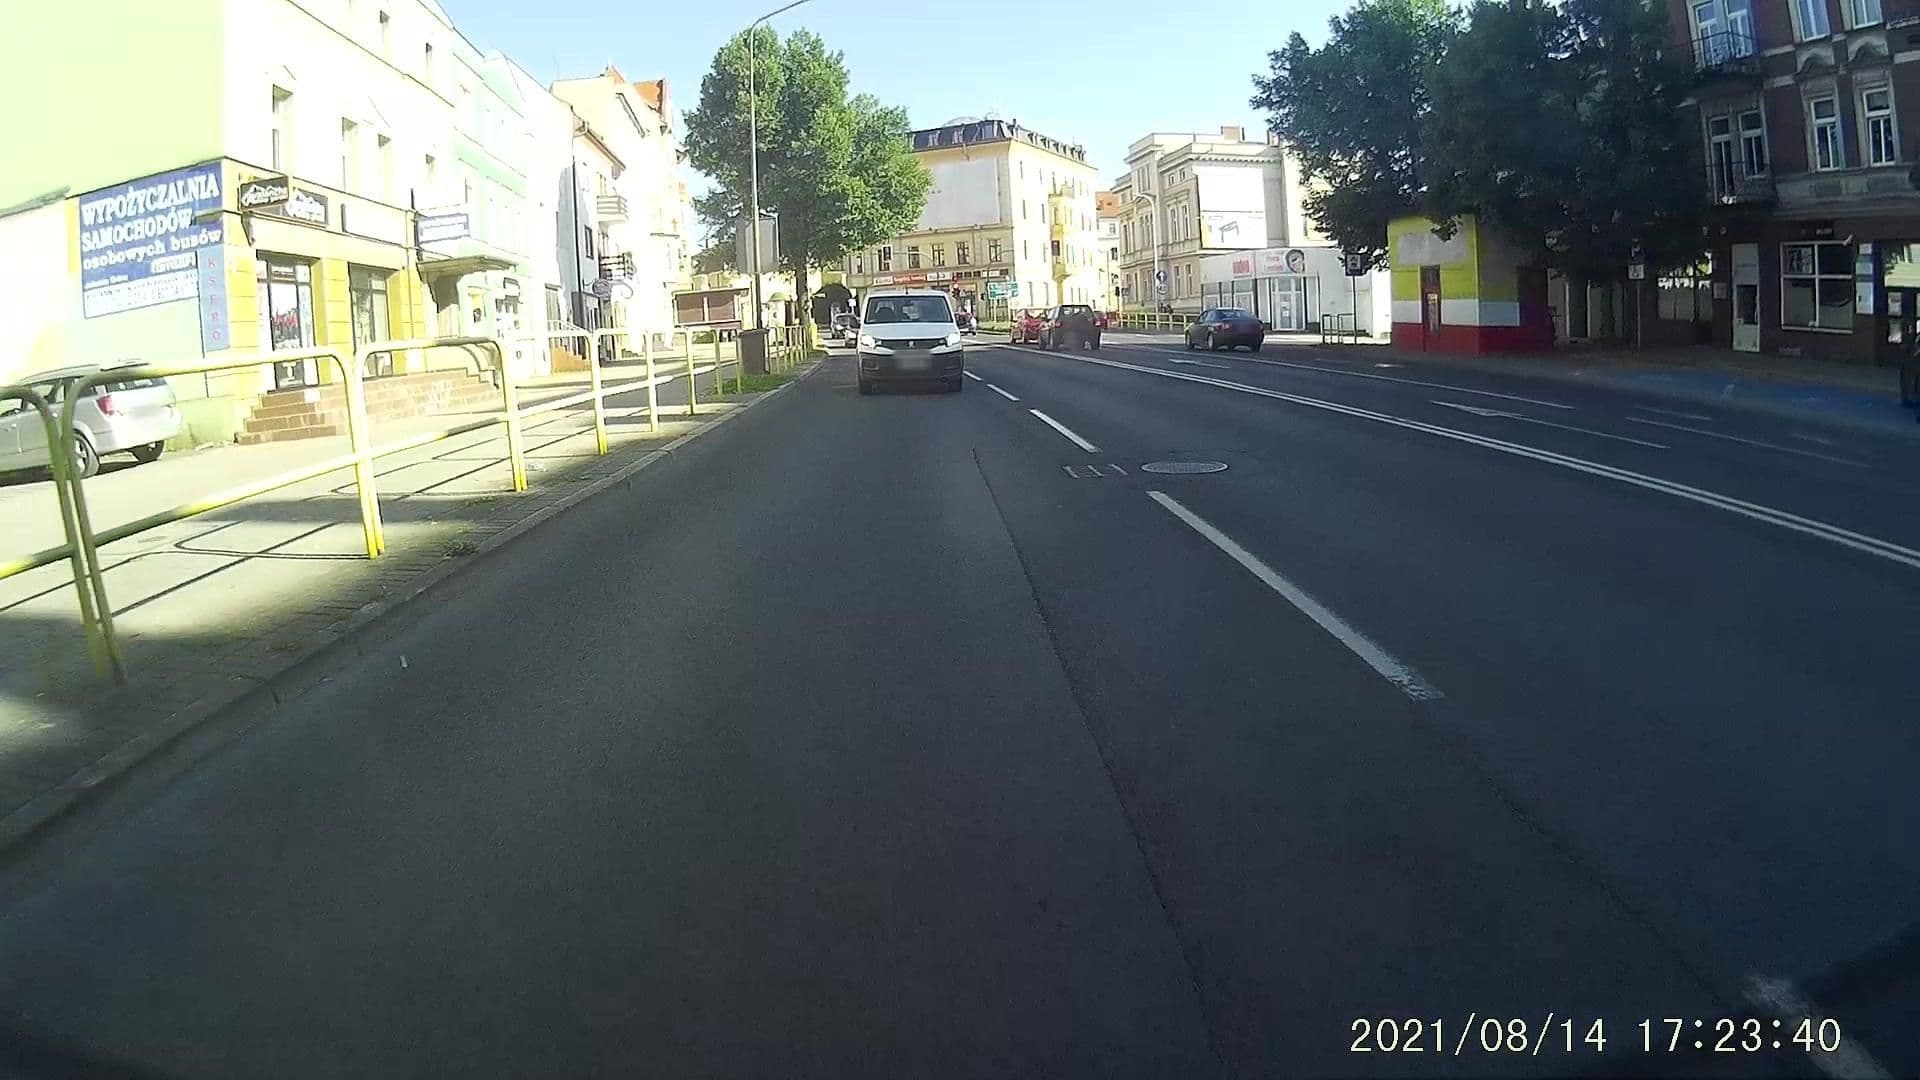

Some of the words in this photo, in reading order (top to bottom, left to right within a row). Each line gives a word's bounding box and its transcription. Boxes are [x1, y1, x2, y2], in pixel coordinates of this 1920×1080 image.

[82, 174, 219, 225] WYPOŻYCZALNIA
[82, 207, 193, 251] SAMOCHODÓW
[84, 240, 165, 269] osobowych
[171, 229, 221, 250] busów
